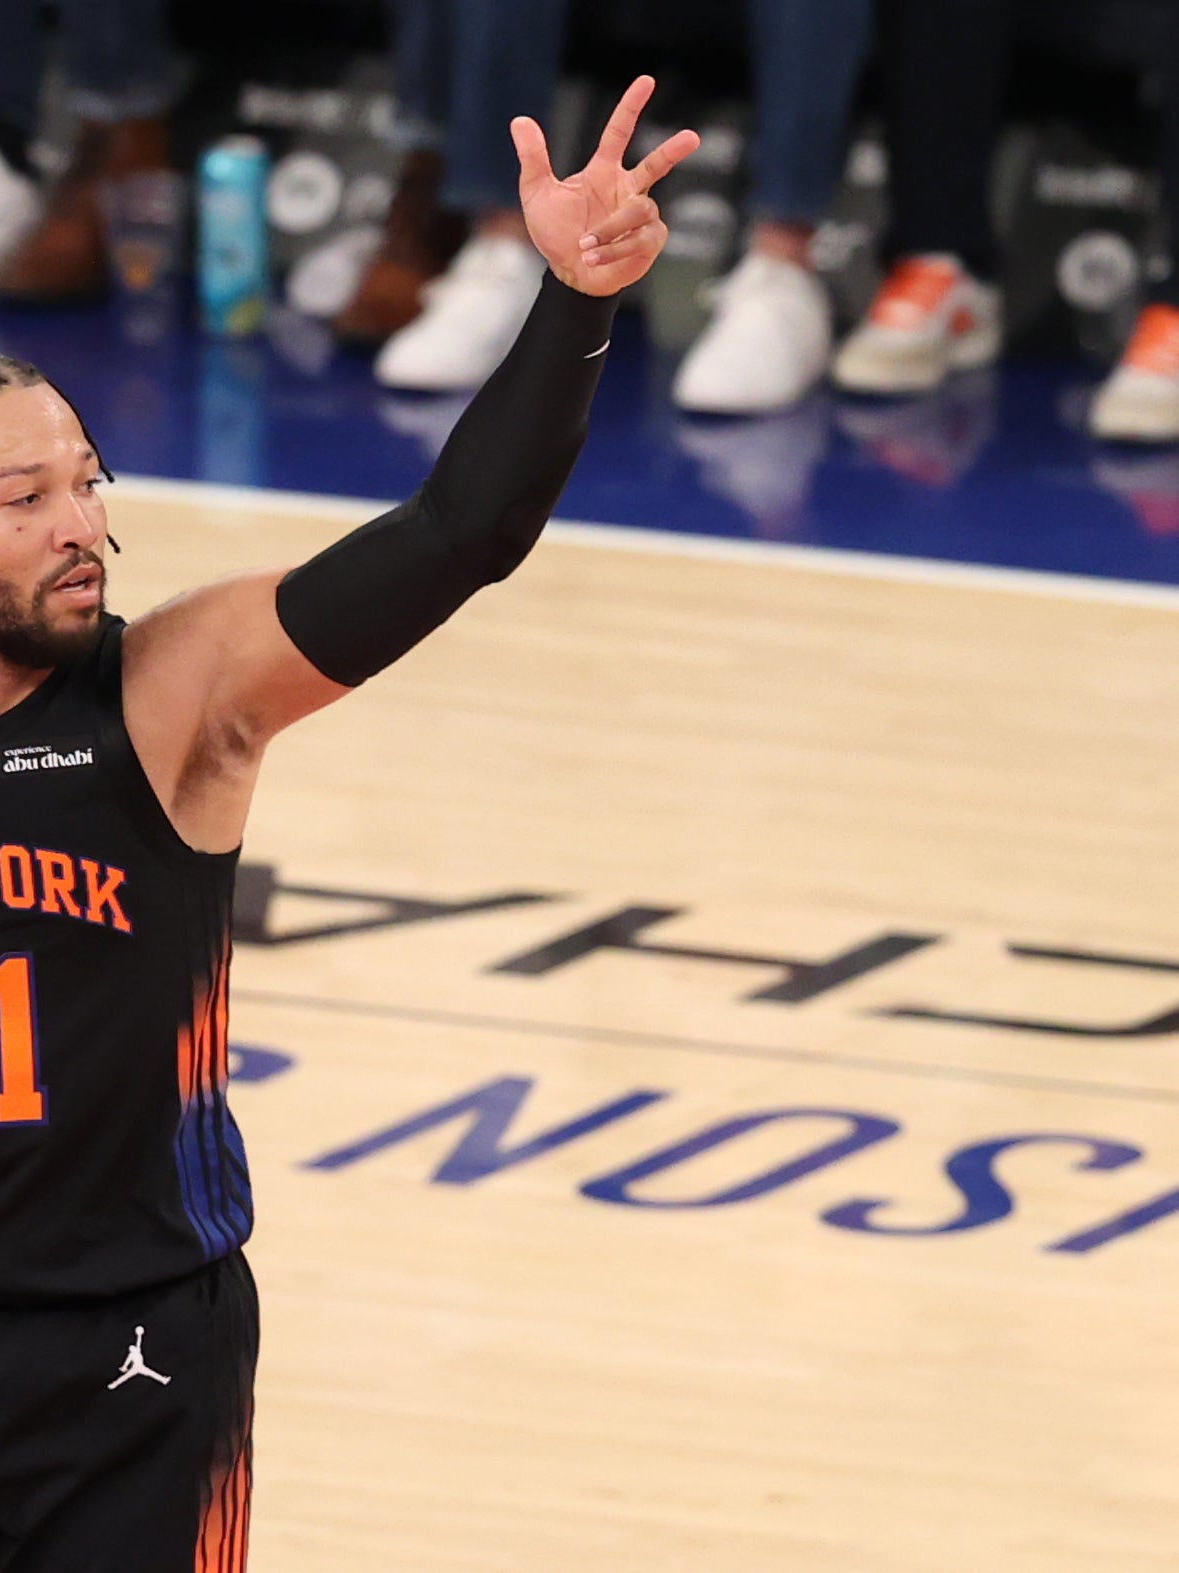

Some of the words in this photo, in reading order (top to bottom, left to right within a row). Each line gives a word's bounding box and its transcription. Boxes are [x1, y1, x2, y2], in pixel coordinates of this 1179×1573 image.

[2, 756, 39, 773] abu
[40, 747, 94, 769] dhabi
[3, 744, 53, 757] experience
